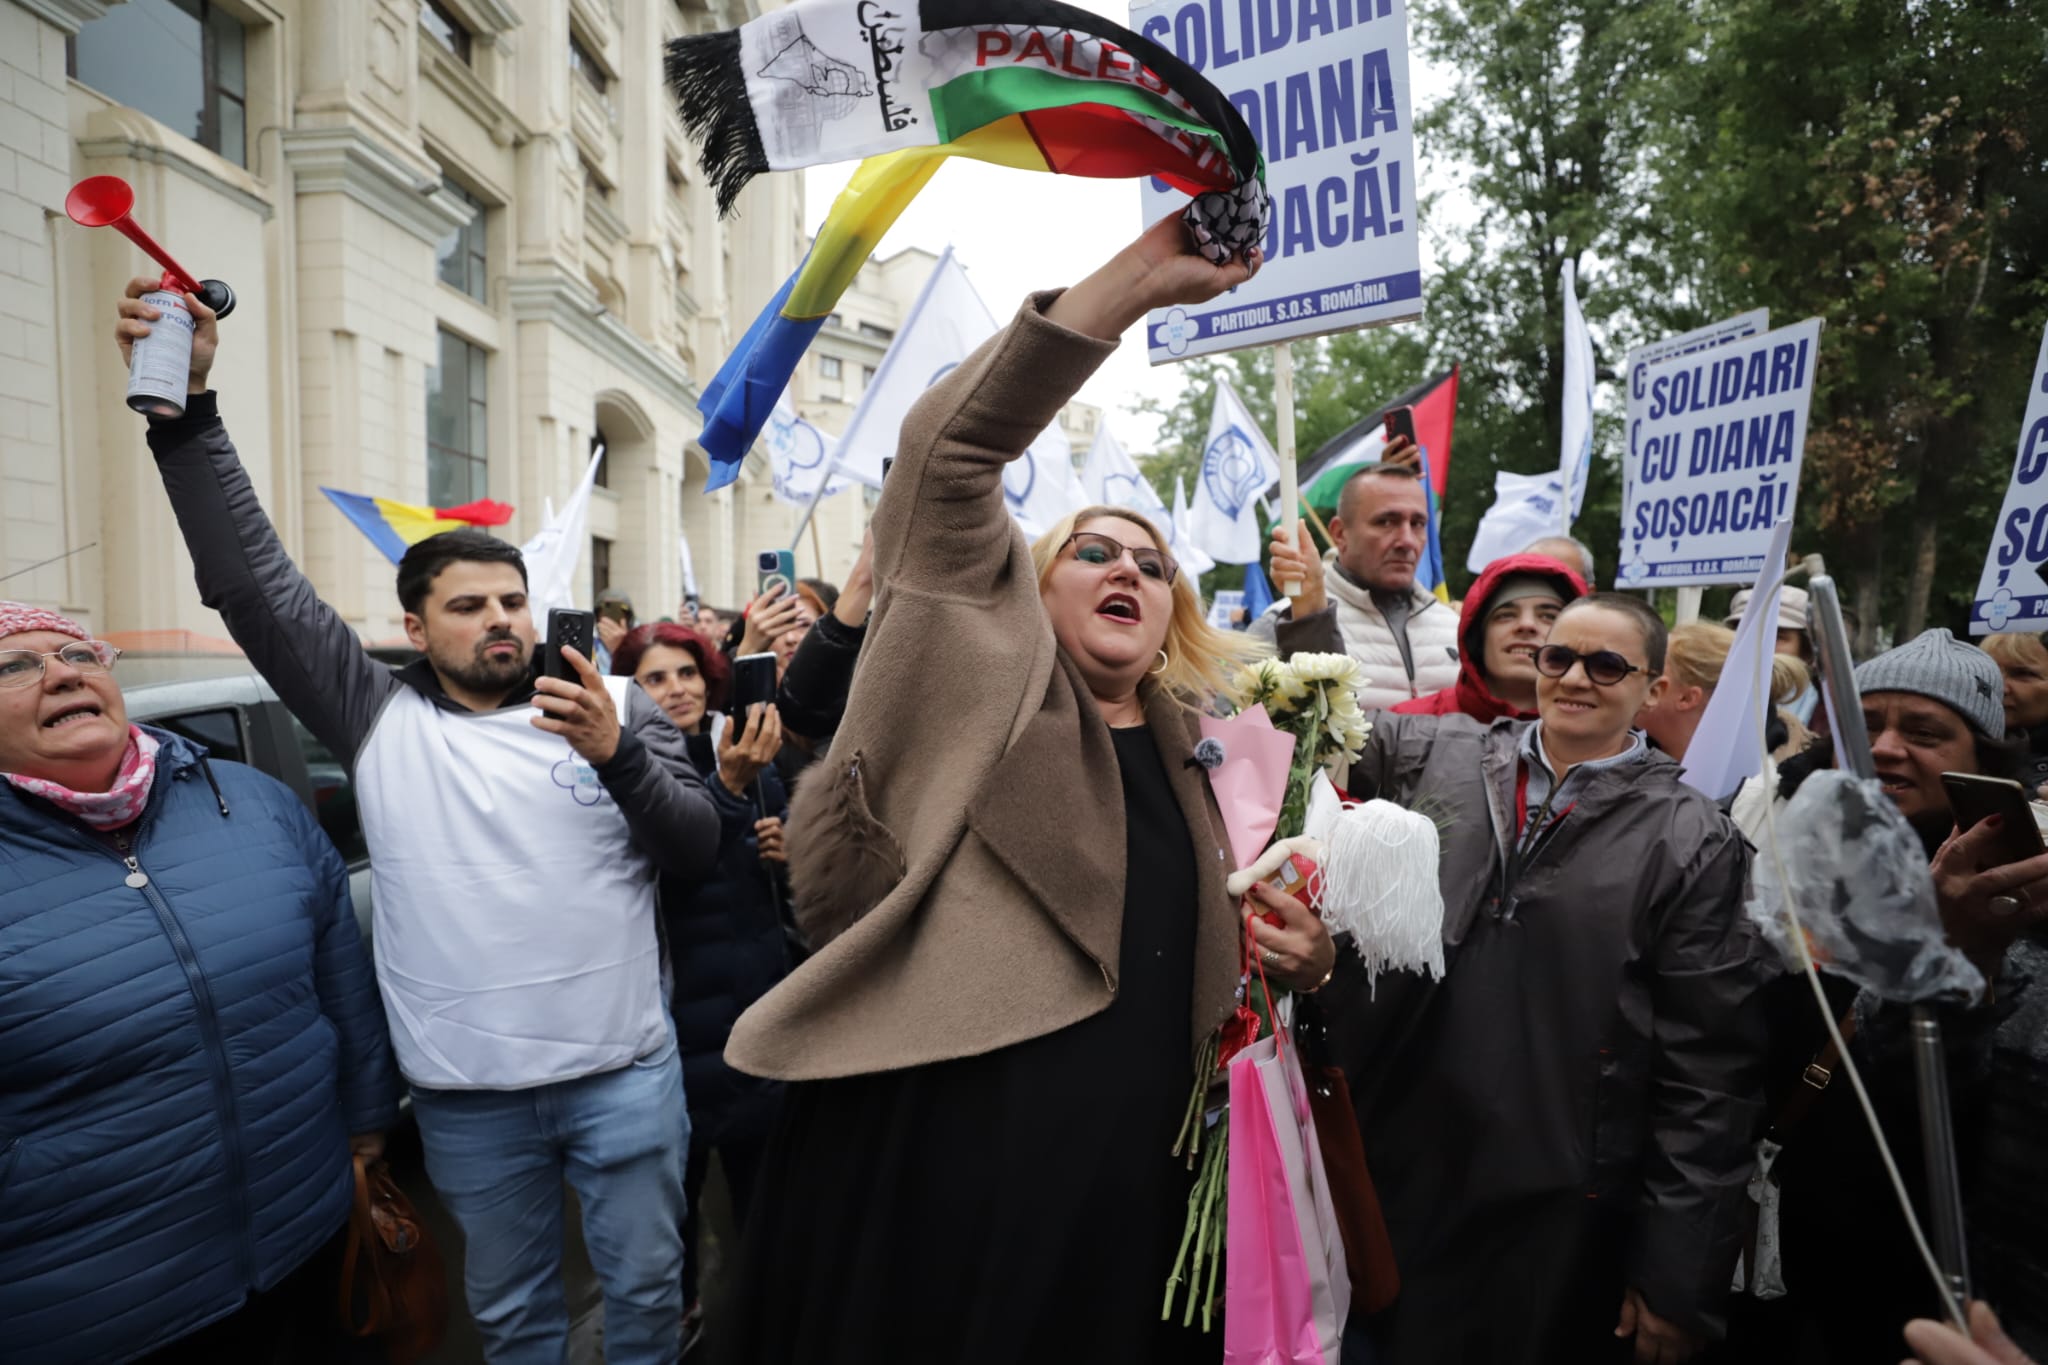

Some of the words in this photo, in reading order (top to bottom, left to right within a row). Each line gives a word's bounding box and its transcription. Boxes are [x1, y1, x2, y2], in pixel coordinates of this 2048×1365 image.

[1212, 306, 1273, 334] PARTIDUL
[1276, 297, 1317, 322] S.O.S.
[1320, 282, 1388, 313] ROMÂNIA
[1649, 338, 1809, 421] SOLIDARI
[1641, 431, 1681, 484] CU
[1688, 409, 1795, 478] DIANA
